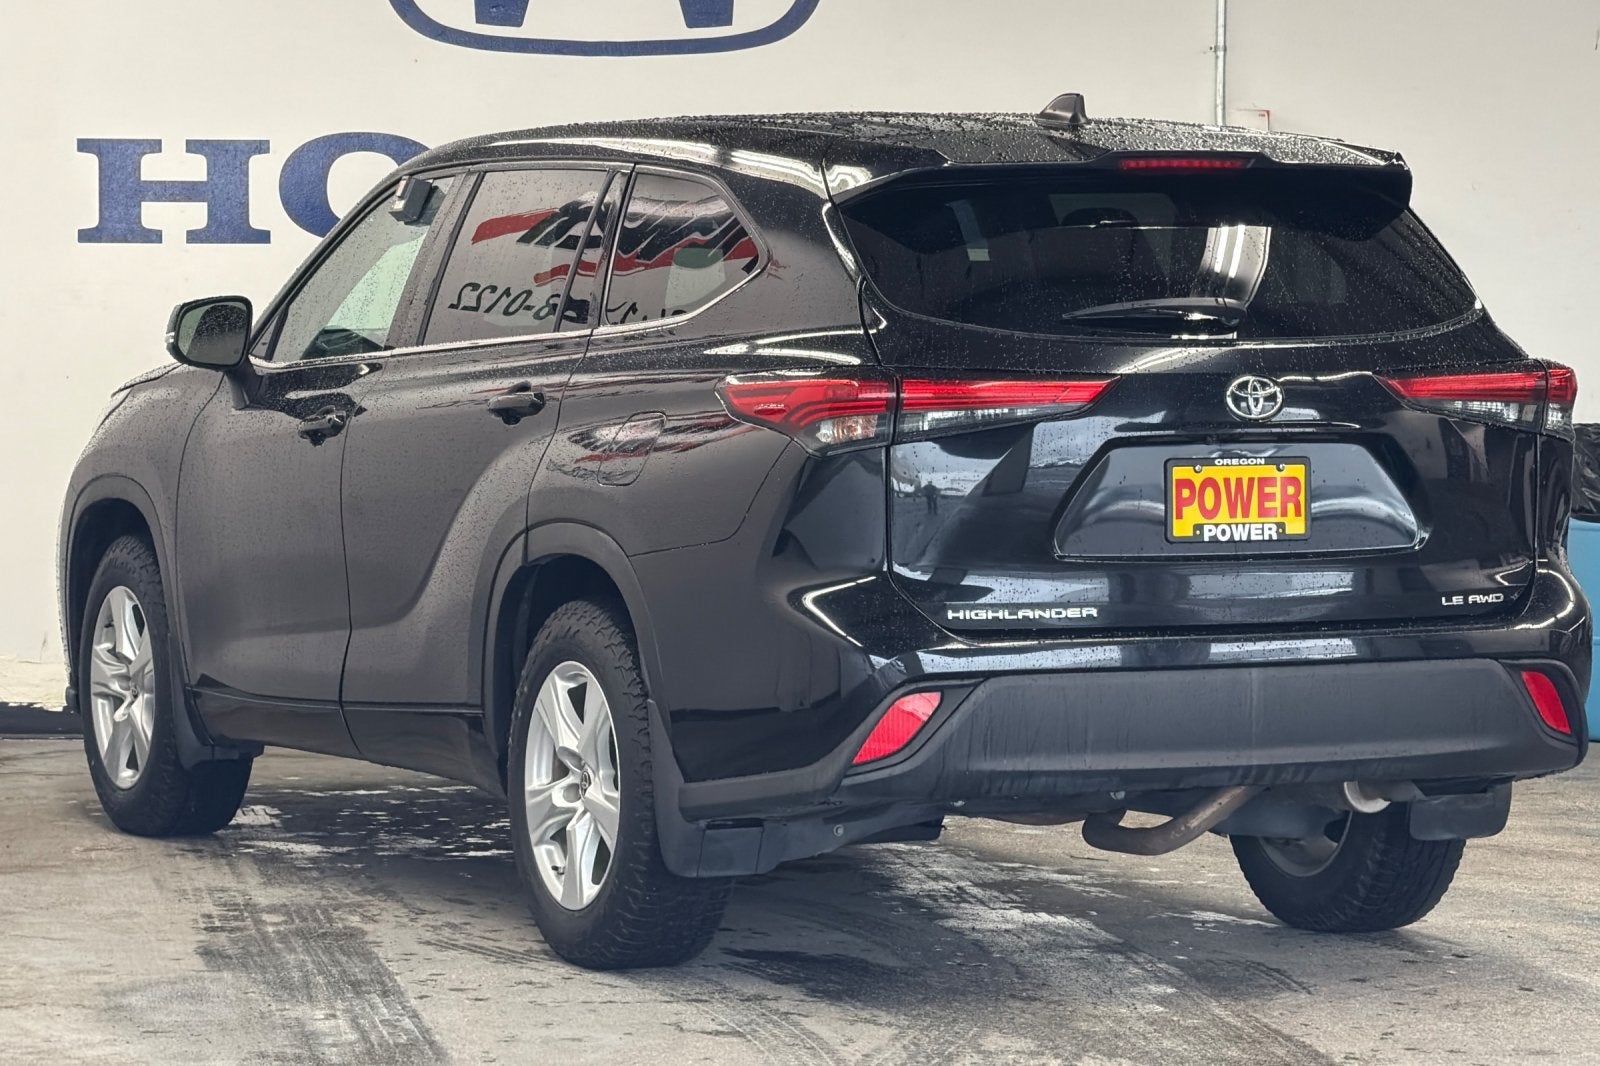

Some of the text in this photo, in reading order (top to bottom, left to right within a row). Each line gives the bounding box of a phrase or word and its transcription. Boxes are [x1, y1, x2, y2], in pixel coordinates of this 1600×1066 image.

[1214, 457, 1266, 466] OREGON
[1174, 476, 1303, 520] POWER
[1203, 523, 1278, 542] POWER
[1441, 593, 1504, 606] LE AWD
[947, 607, 1098, 620] HIGHLANDER
